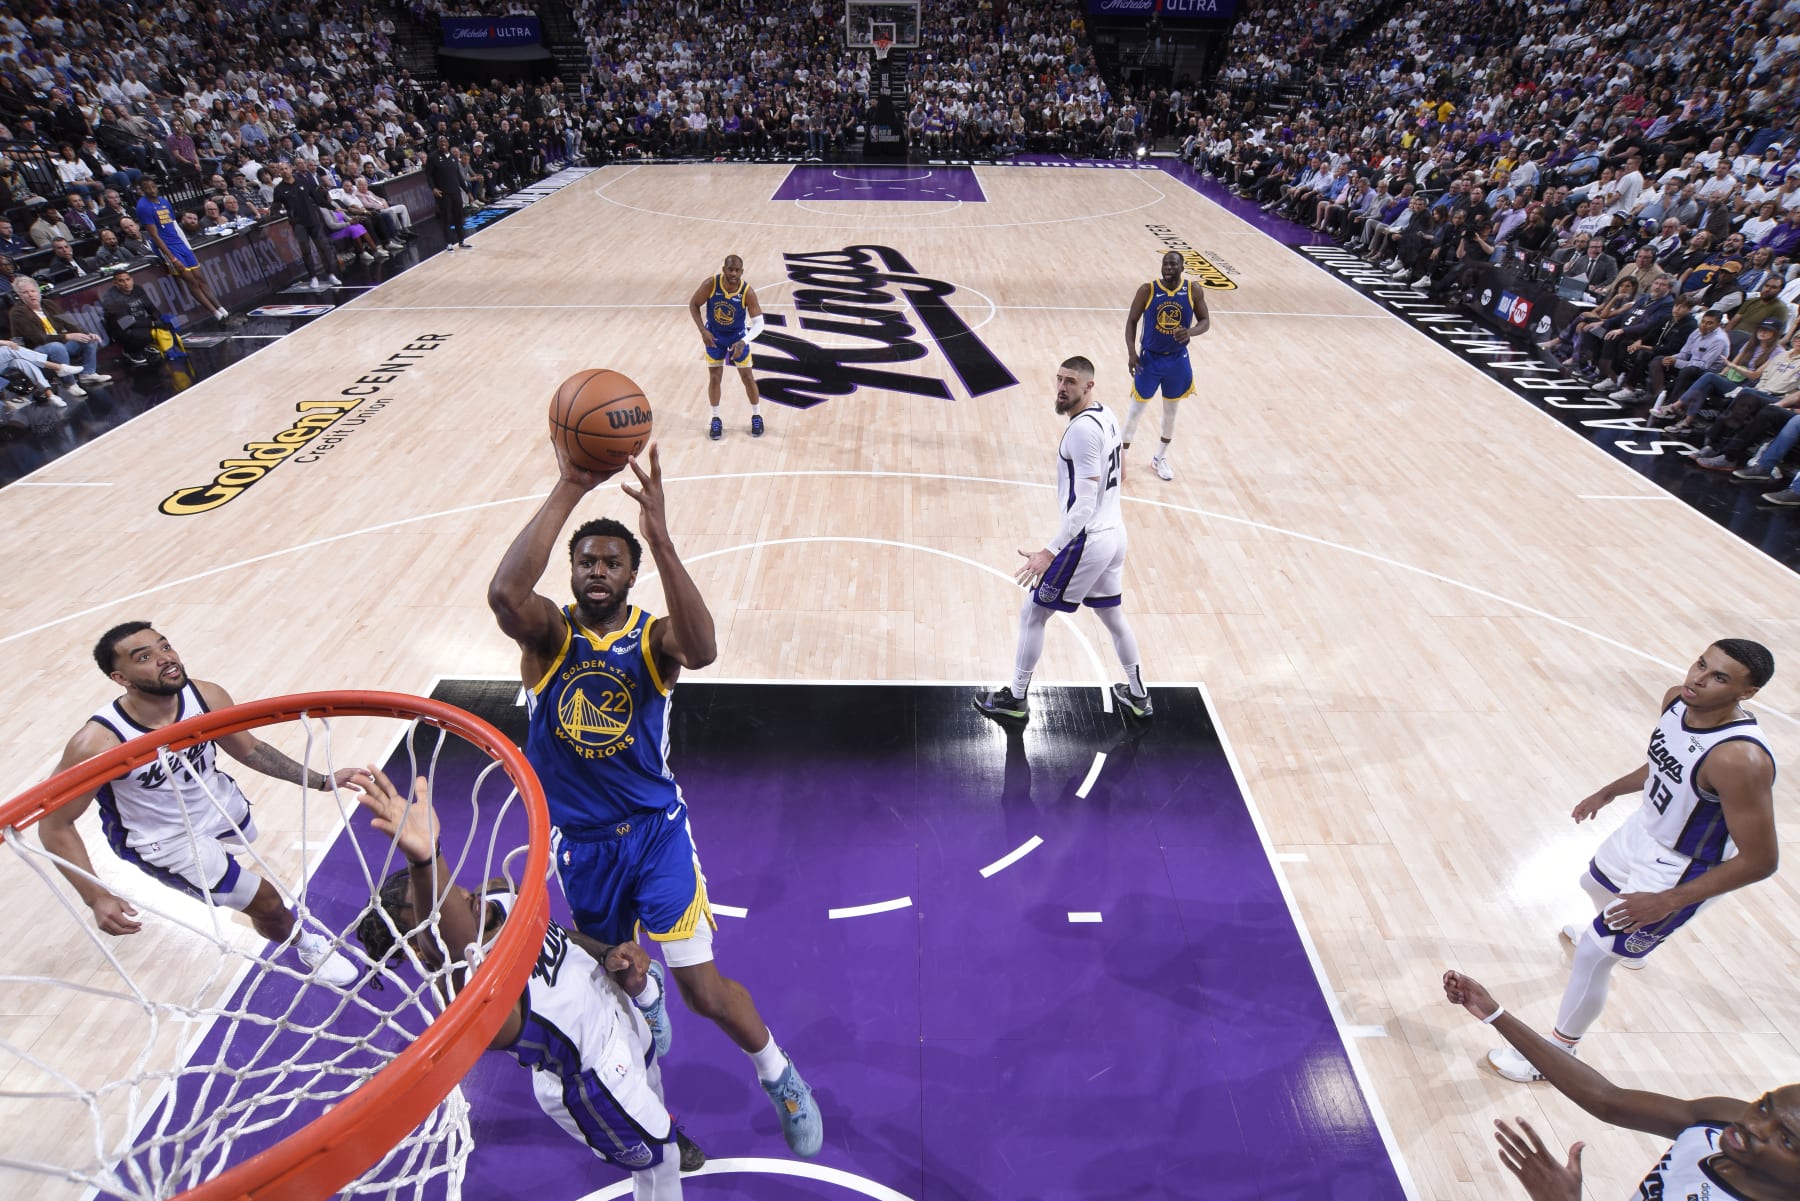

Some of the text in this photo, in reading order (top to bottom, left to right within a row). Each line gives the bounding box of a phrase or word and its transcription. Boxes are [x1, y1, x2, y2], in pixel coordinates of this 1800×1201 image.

[1166, 0, 1217, 11] ULTRA
[452, 27, 532, 39] Michelob ULTRA
[1145, 224, 1193, 250] CENTER
[726, 245, 1020, 409] Kings
[1169, 309, 1179, 318] 23
[341, 333, 454, 396] CENTER
[1300, 245, 1700, 456] SACRAMENTO PROUD
[294, 398, 394, 463] Credit Union
[562, 660, 637, 690] GOLDEN STATE
[599, 691, 628, 713] 22
[555, 727, 635, 759] WARRIORS
[1647, 727, 1684, 784] Kings
[1649, 774, 1674, 816] 13
